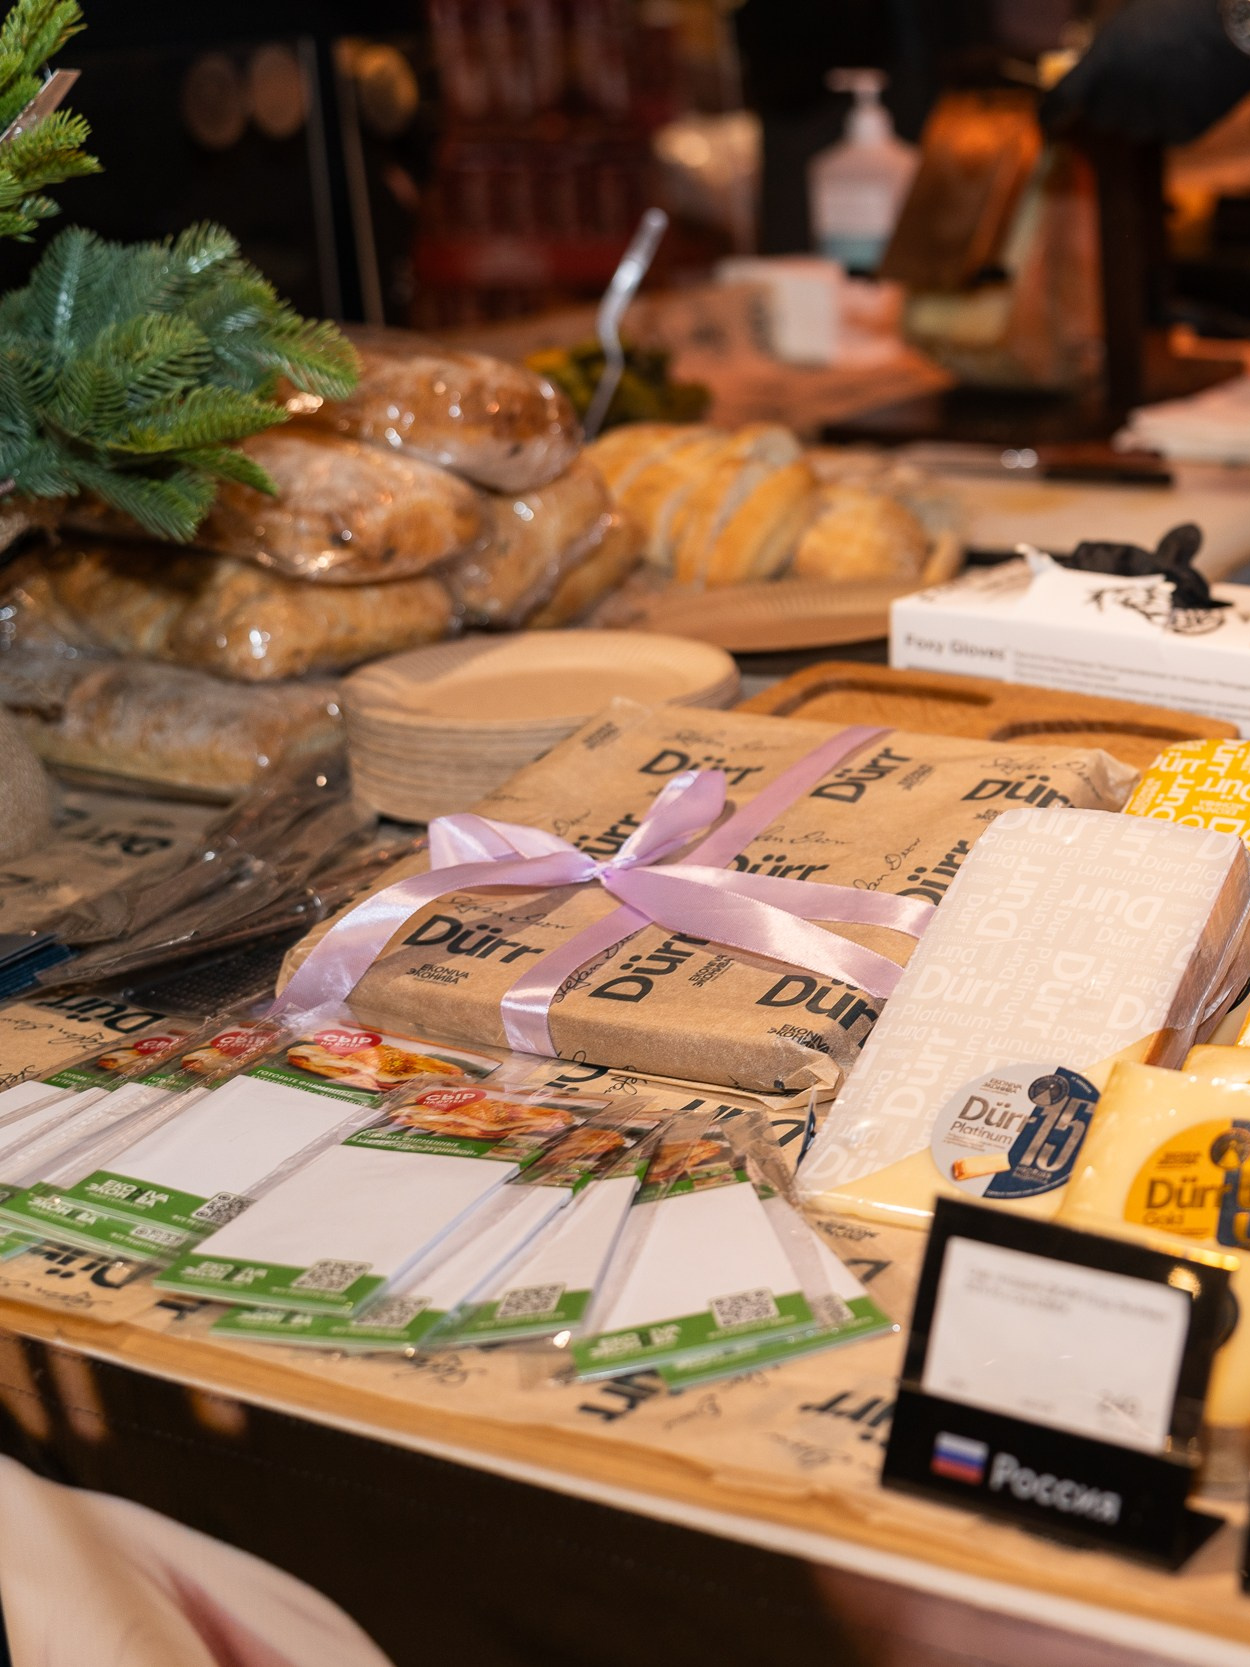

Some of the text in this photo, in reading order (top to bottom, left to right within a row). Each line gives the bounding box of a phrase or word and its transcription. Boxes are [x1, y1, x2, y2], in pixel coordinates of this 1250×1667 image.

[639, 749, 765, 786] Dr
[811, 747, 912, 803] Dürr
[960, 774, 1076, 808] Dür
[573, 813, 643, 859] ürr
[979, 832, 1082, 859] Platinum
[1112, 820, 1176, 867] ürr
[1141, 854, 1187, 875] Dürr
[975, 857, 1047, 939] Dürr
[1060, 885, 1166, 931] Dürr
[402, 914, 545, 964] Dürr
[1095, 925, 1138, 949] Dürr
[419, 963, 470, 979] EKONIVA
[588, 932, 711, 1003] Dürr
[910, 963, 1010, 1008] Dürr
[755, 975, 880, 1049] Dür
[1022, 950, 1097, 1039] Dürr
[900, 1003, 992, 1030] Platinum
[1052, 1024, 1095, 1046] Dürr
[323, 1034, 373, 1044] СЫР
[881, 1027, 957, 1120] Dürr
[424, 1092, 477, 1101] СЫР
[958, 1094, 1037, 1132] Dürr
[949, 1120, 1013, 1145] Platinum
[1020, 1096, 1099, 1172] 15
[1144, 1177, 1233, 1210] Dürr
[989, 1452, 1122, 1526] Россия
